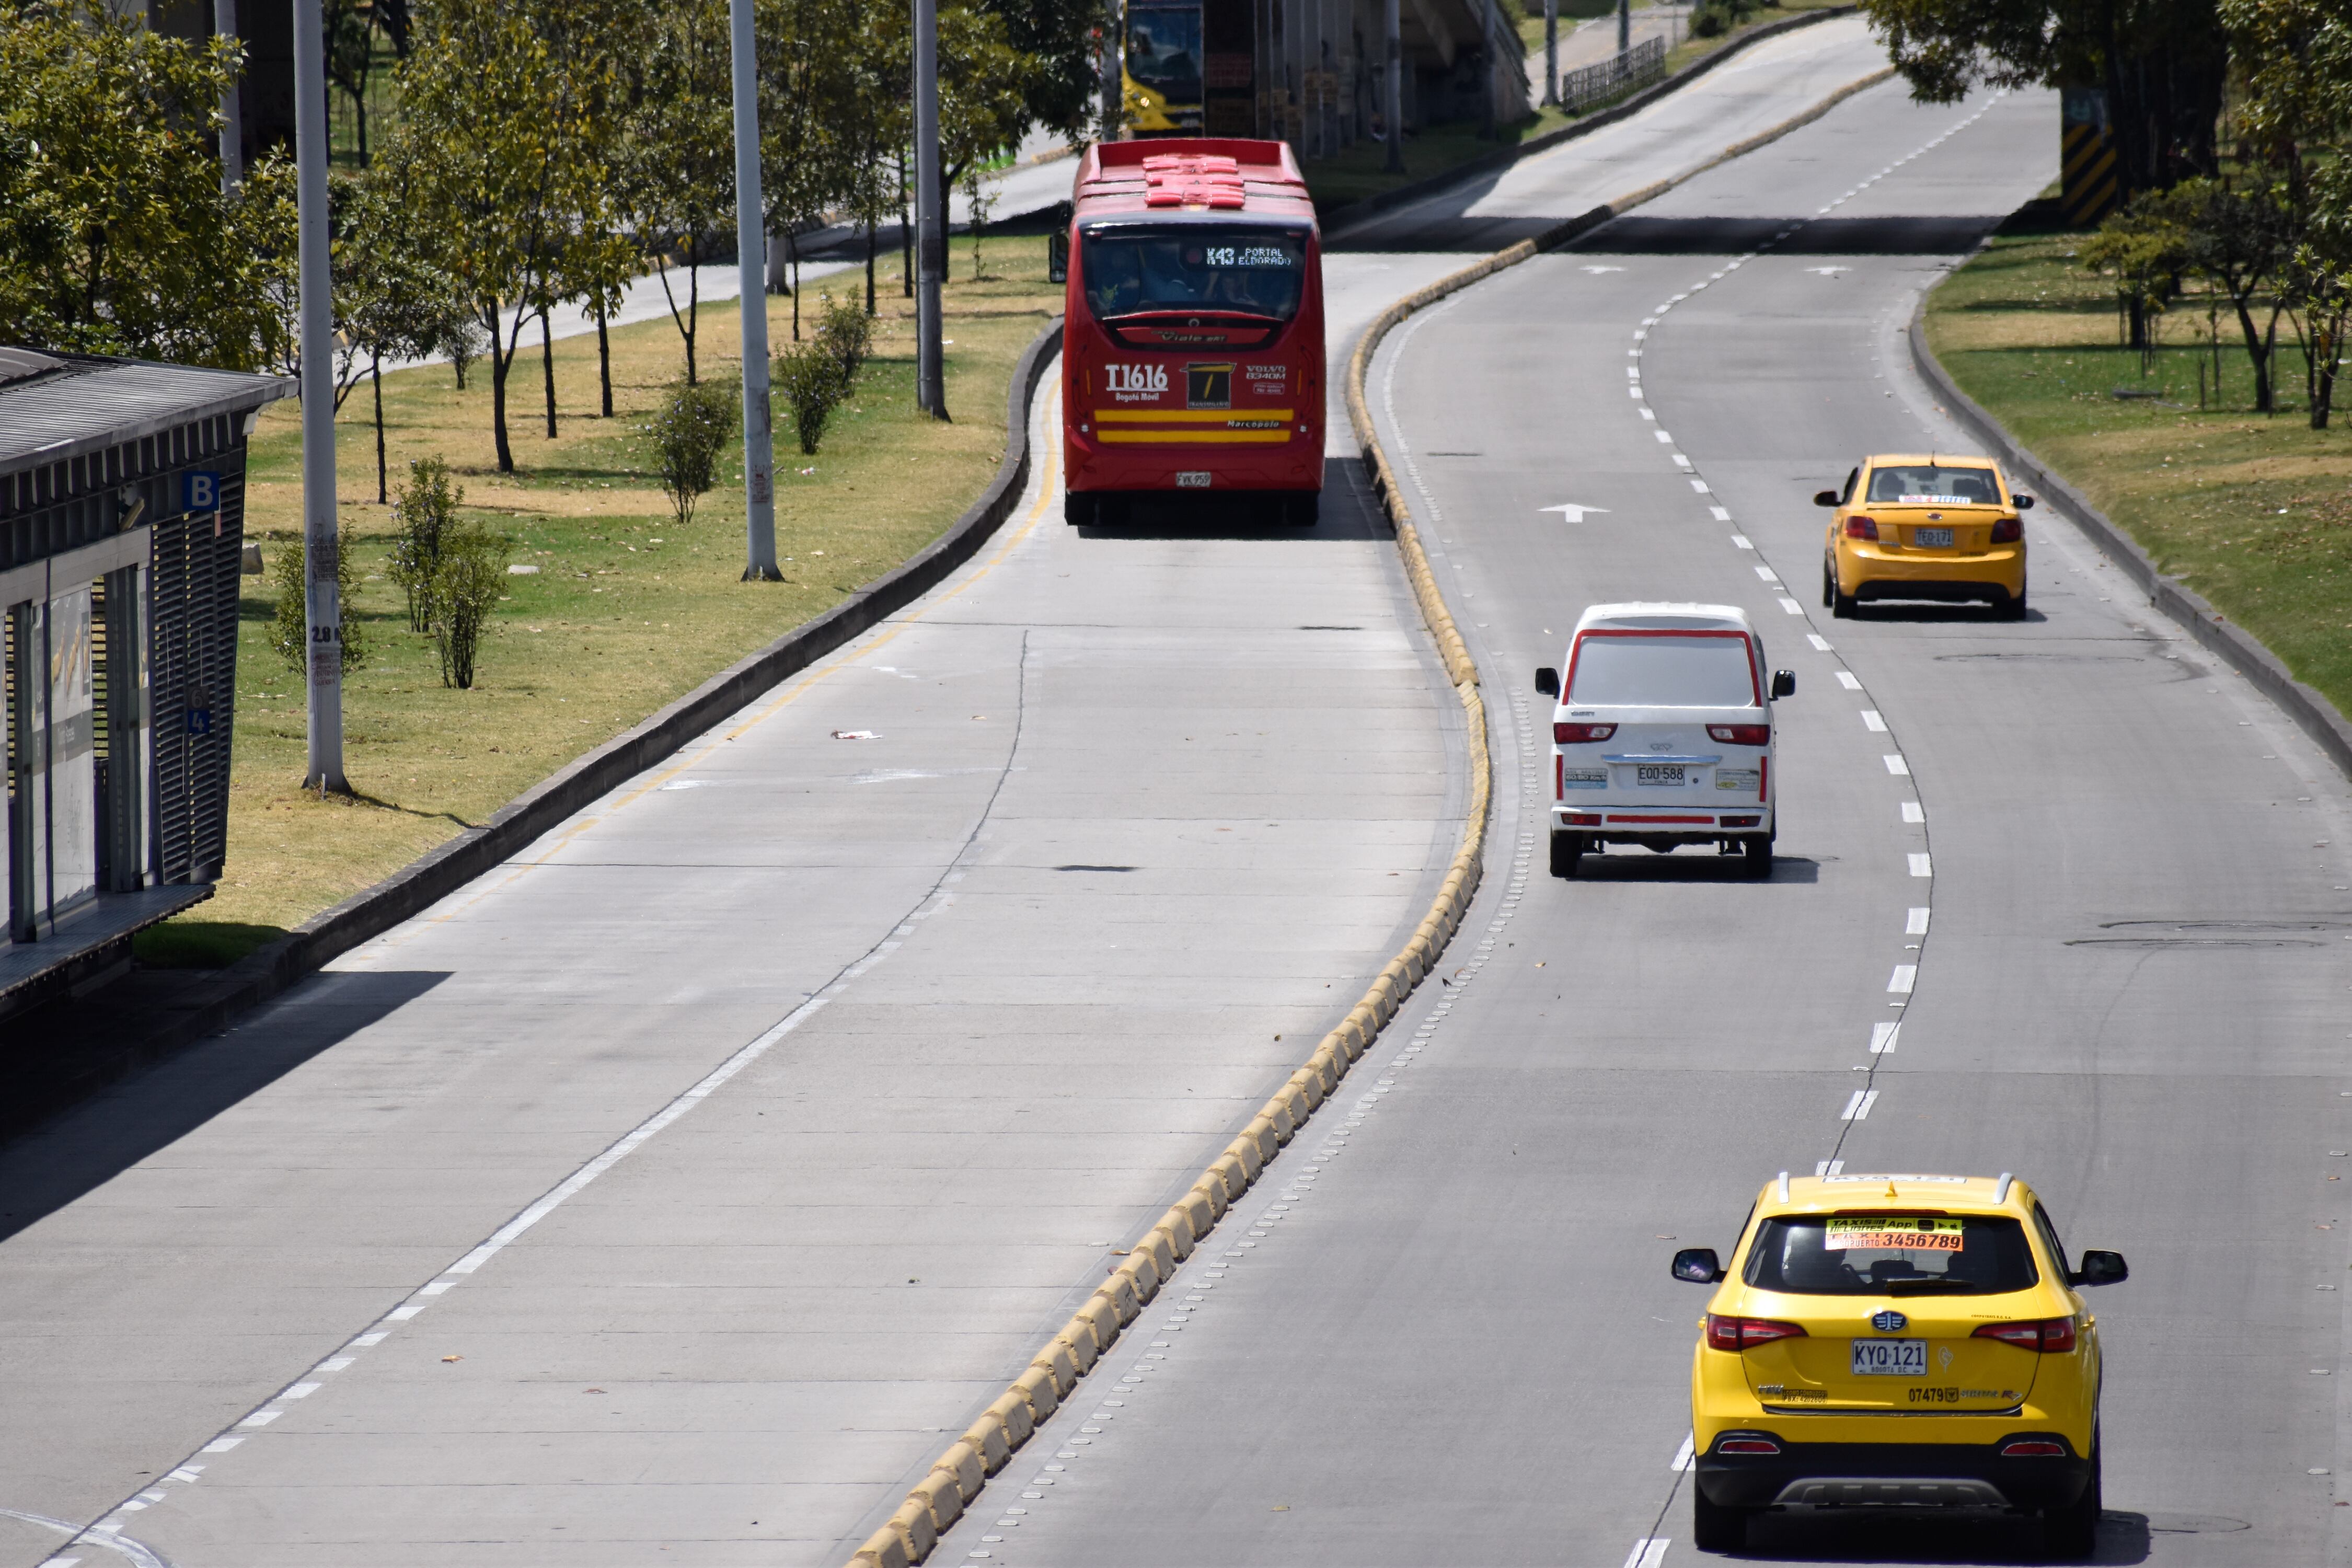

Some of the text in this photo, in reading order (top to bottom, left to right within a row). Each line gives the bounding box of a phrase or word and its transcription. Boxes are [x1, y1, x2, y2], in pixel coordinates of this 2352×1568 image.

[1207, 247, 1283, 265] K43 PORTAL
[1105, 364, 1169, 391] T1616
[1227, 420, 1280, 428] Marcopolo
[192, 476, 213, 506] B
[191, 688, 203, 709] 6
[192, 711, 204, 731] 4
[1887, 1220, 1912, 1229] App
[1883, 1233, 1961, 1249] 3456789
[1909, 1388, 1944, 1402] 07479
